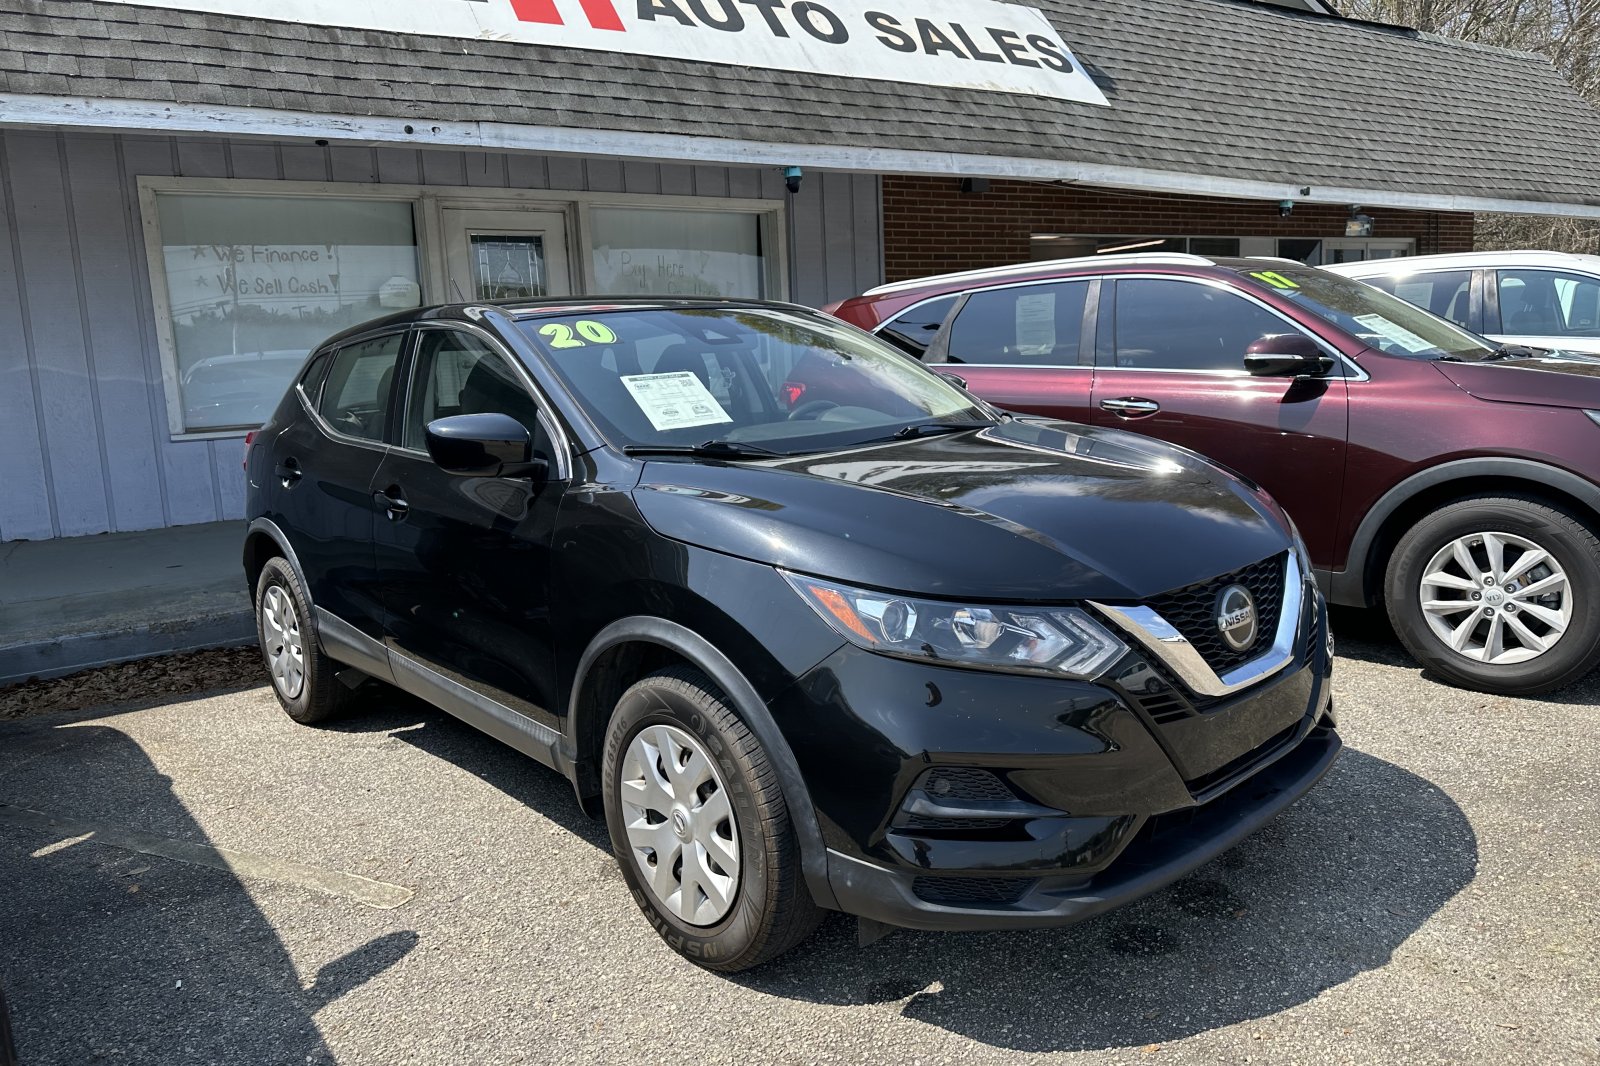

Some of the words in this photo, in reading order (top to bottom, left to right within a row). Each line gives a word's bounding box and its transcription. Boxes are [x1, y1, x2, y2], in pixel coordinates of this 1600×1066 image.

[637, 0, 850, 45] AUTO
[864, 11, 1074, 74] SALES
[212, 245, 245, 263] We
[252, 245, 319, 264] Finance
[657, 255, 685, 278] Here
[216, 274, 249, 295] We
[254, 277, 283, 296] Sell
[1250, 271, 1300, 289] 17
[539, 320, 617, 348] 20
